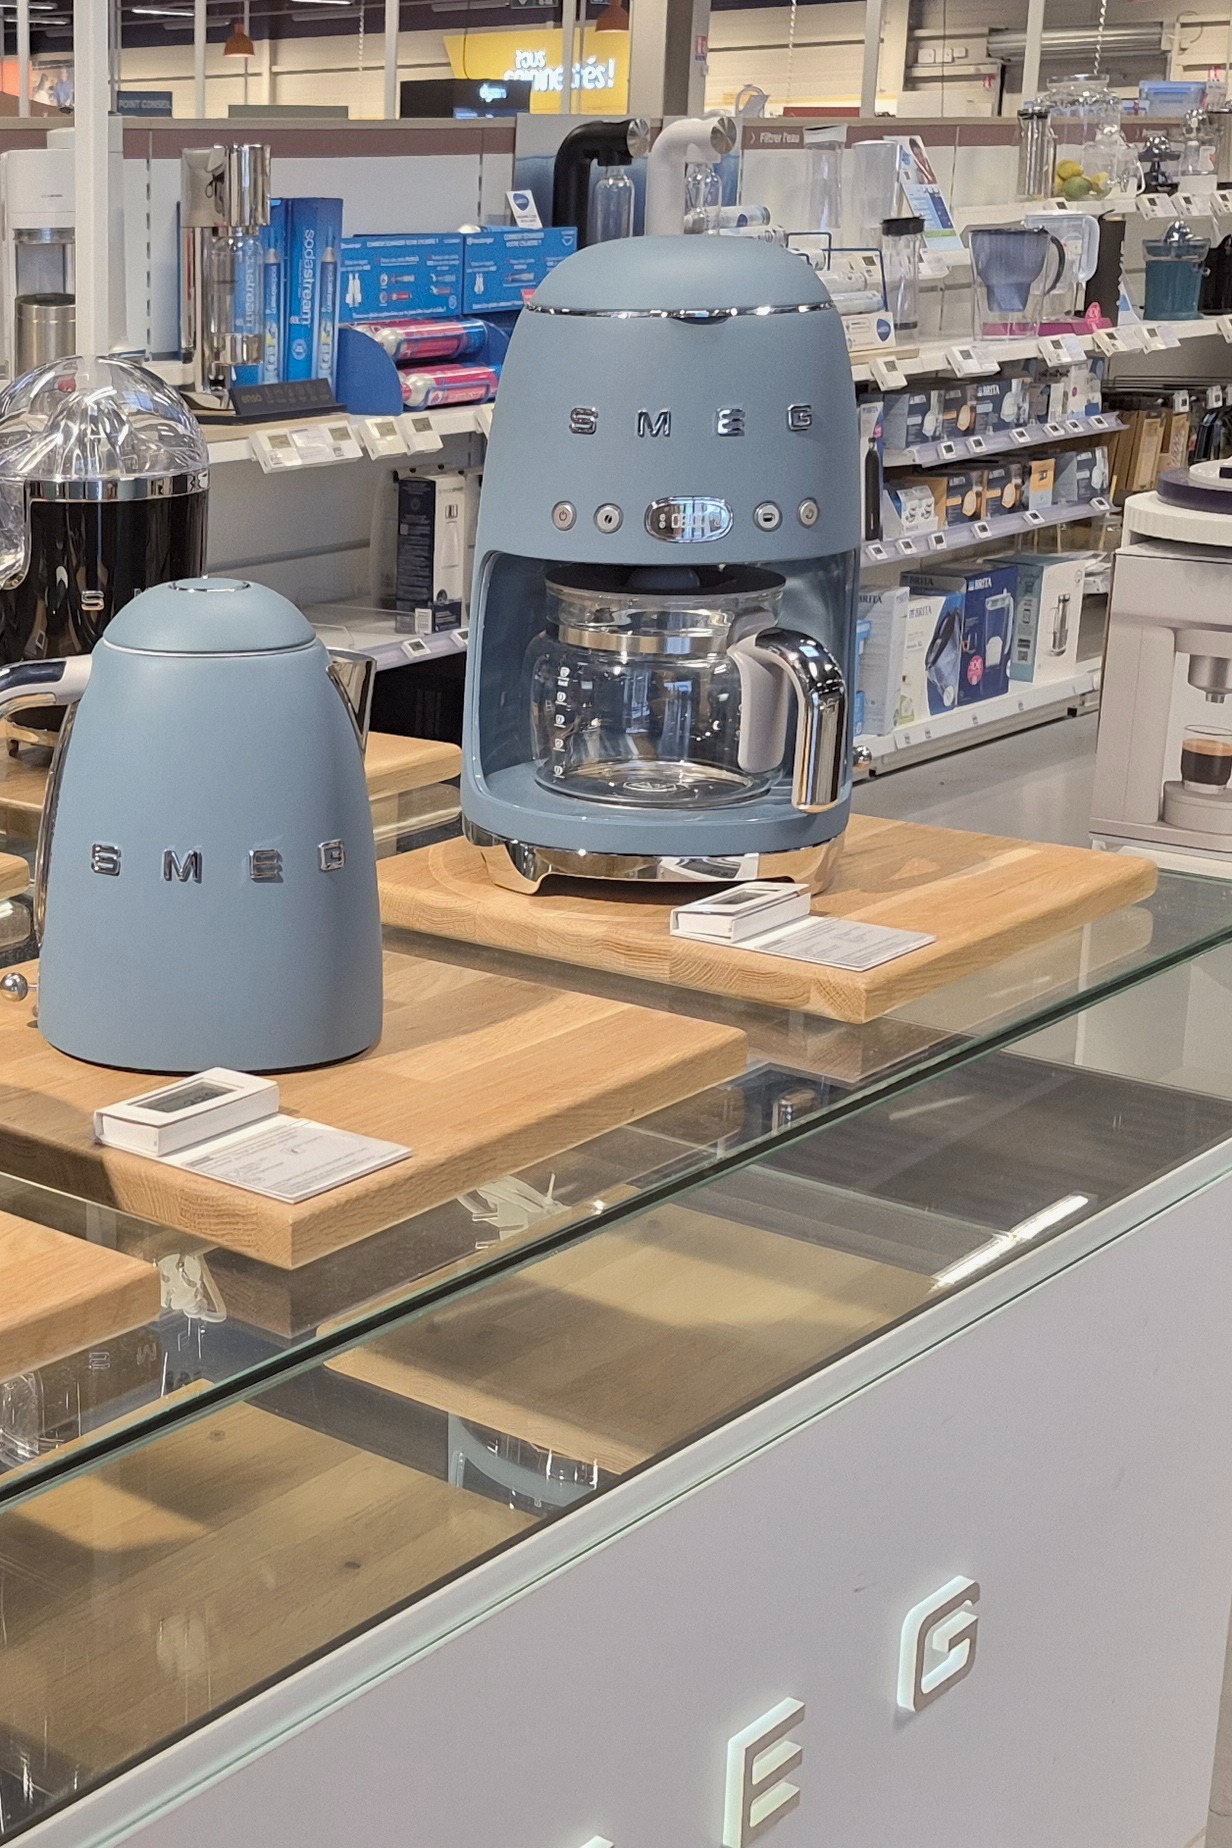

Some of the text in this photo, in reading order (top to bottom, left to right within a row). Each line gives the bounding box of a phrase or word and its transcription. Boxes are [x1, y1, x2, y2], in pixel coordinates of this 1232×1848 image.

[301, 229, 316, 327] sodastream
[569, 404, 813, 438] SMEG
[90, 838, 346, 882] SMEG
